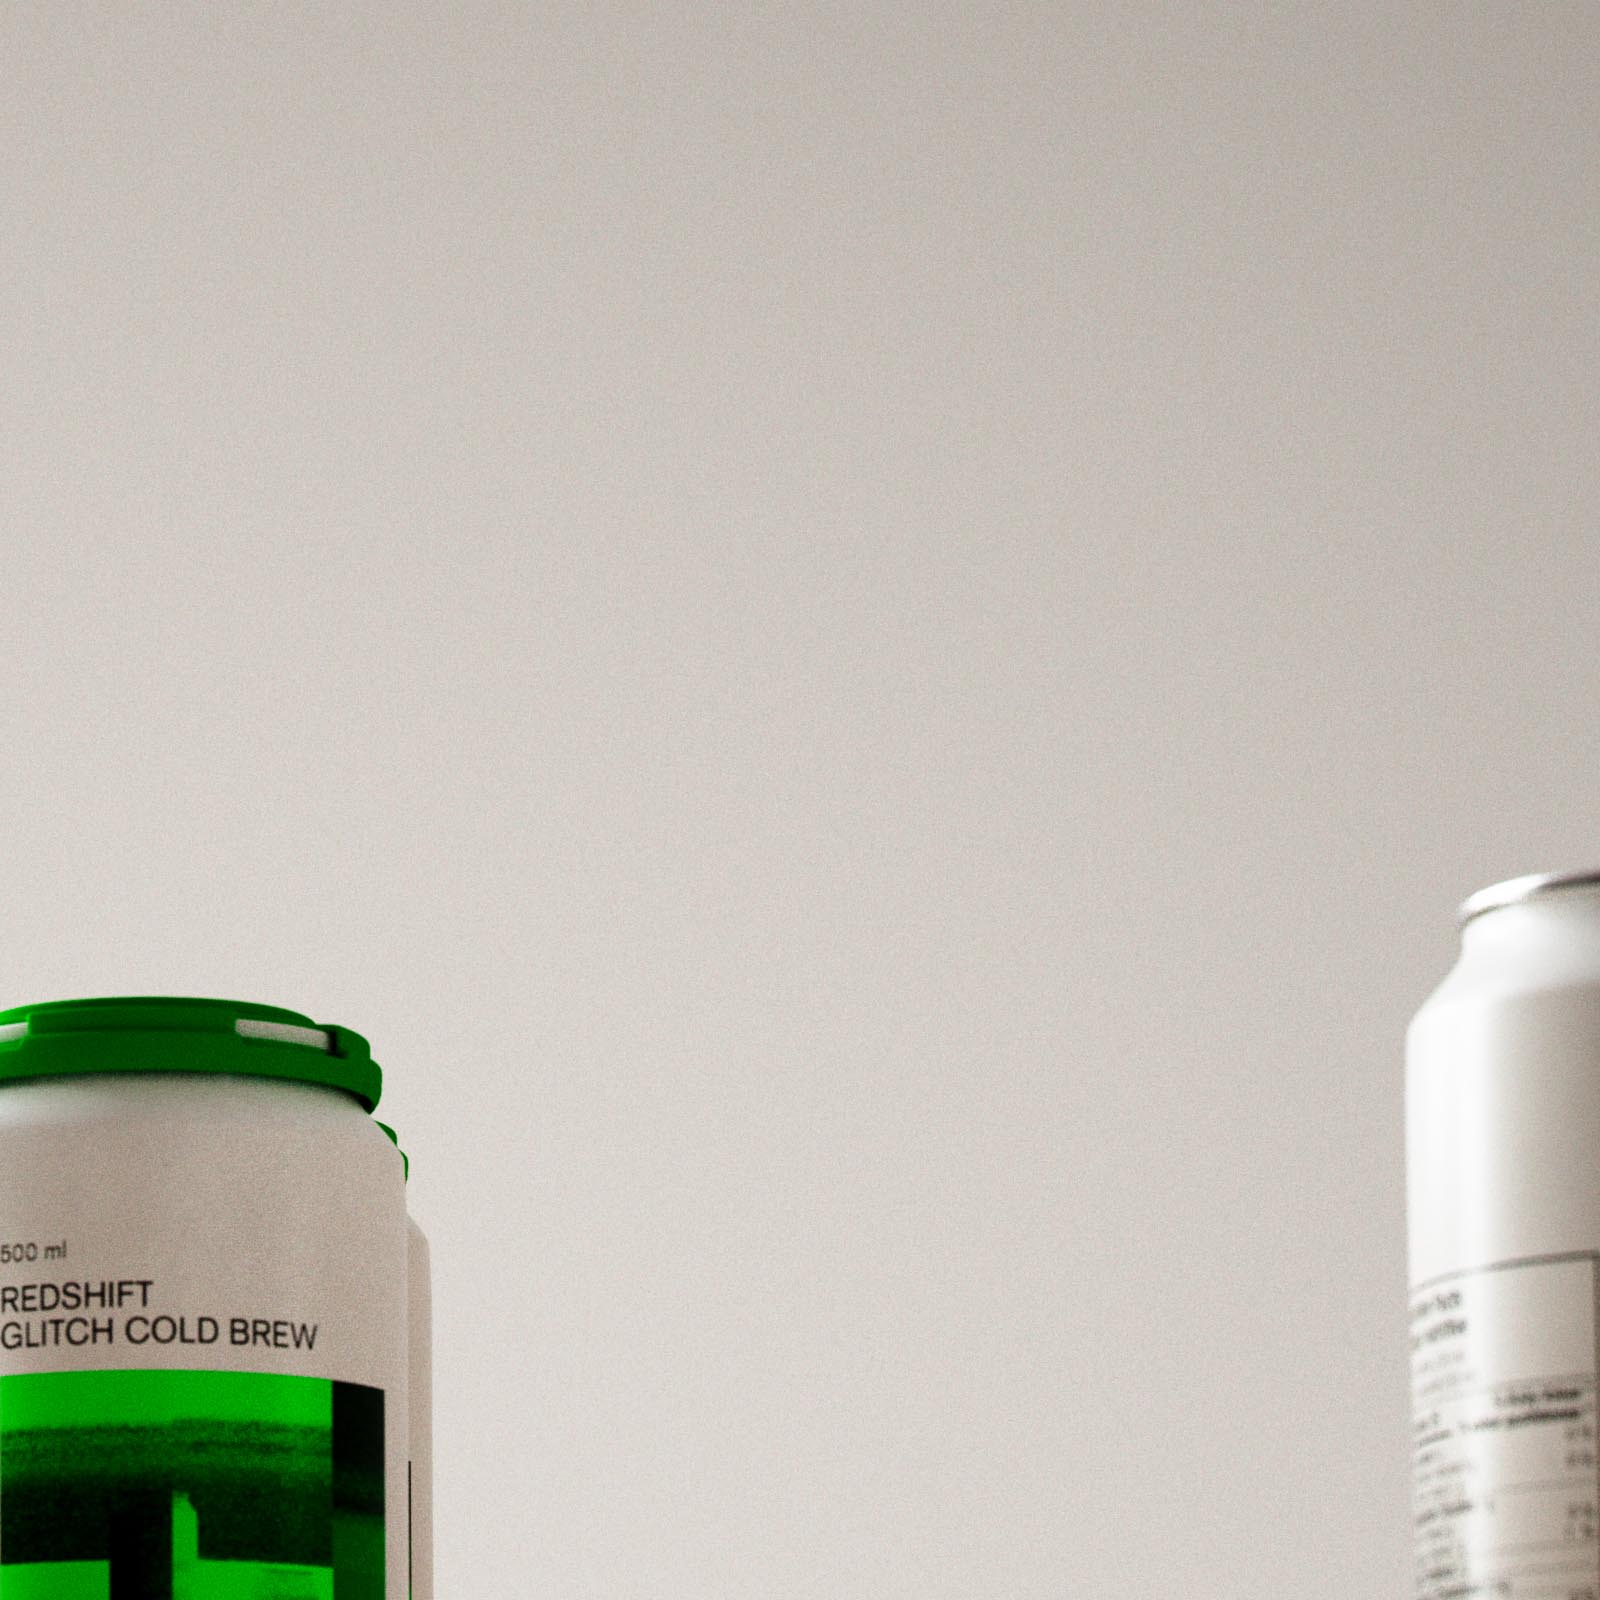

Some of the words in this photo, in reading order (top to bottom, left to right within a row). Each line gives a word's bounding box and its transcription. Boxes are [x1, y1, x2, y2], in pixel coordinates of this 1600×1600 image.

[0, 1242, 38, 1264] 500
[44, 1241, 67, 1259] ml
[0, 1279, 154, 1314] REDSHIFT
[0, 1316, 115, 1351] GLITCH
[124, 1314, 220, 1346] COLD
[229, 1317, 318, 1351] BREW
